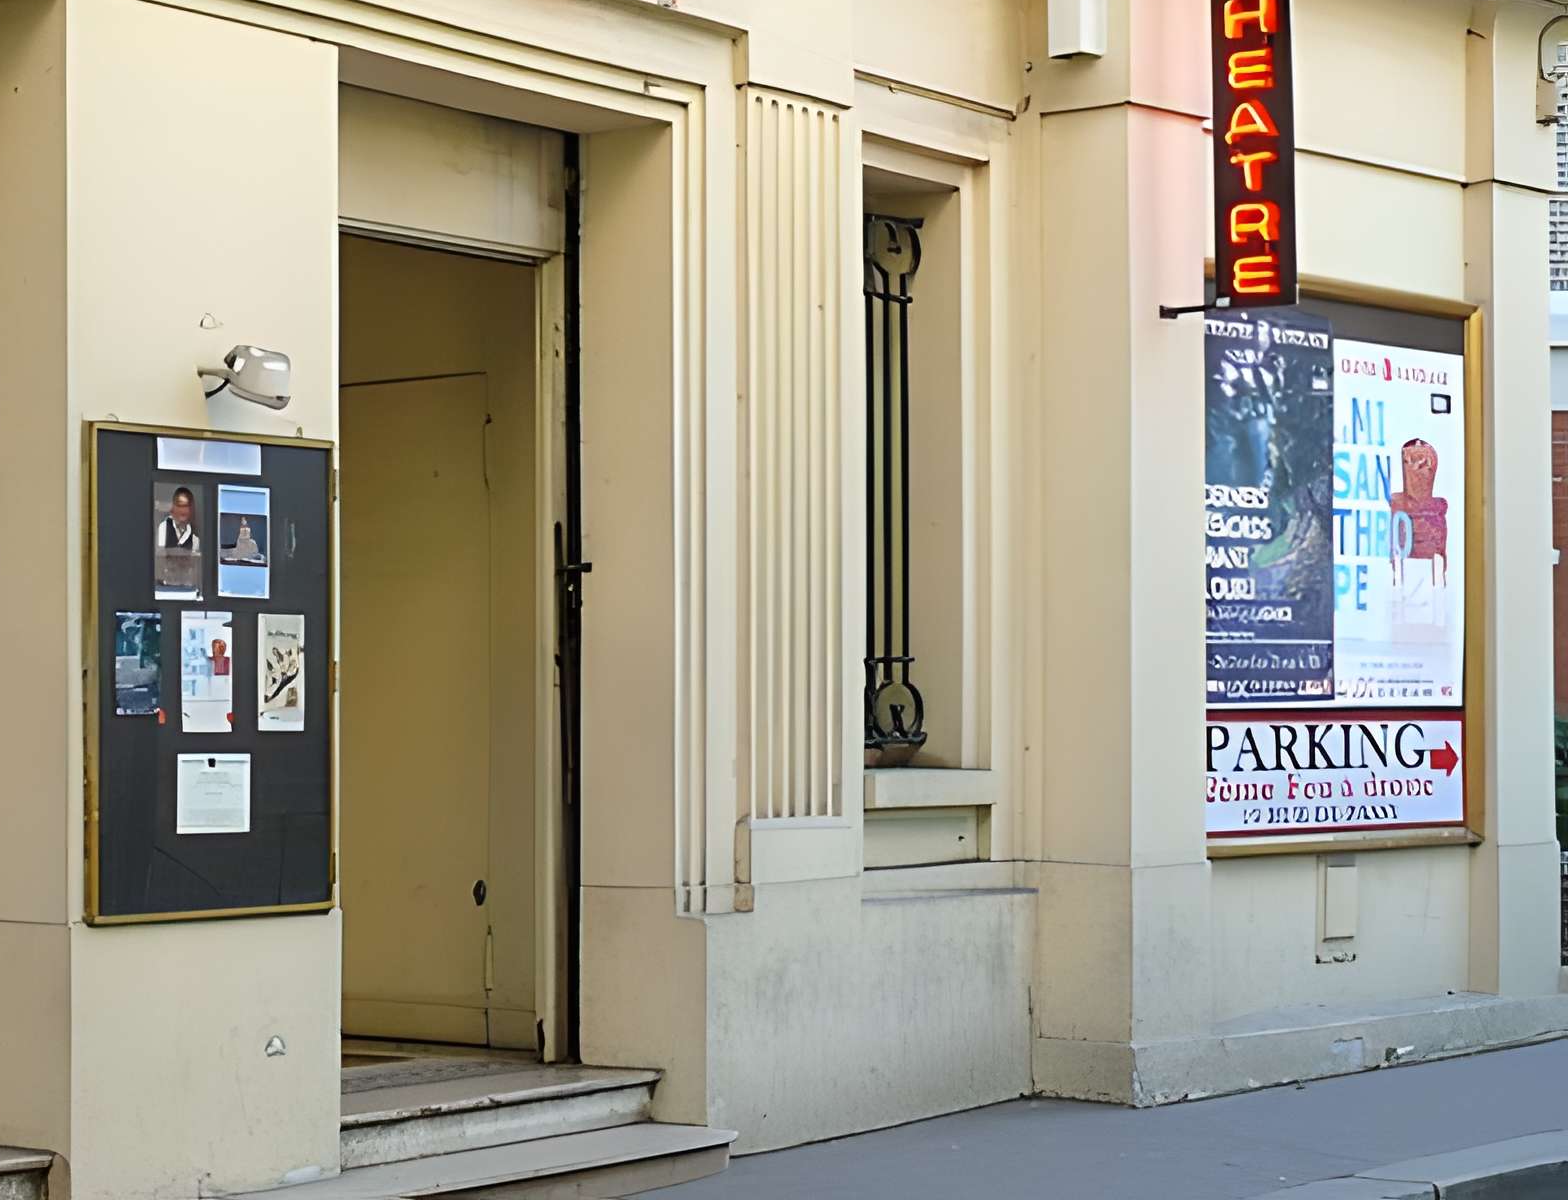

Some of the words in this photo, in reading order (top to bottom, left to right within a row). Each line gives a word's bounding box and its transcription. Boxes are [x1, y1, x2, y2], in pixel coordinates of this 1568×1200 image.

[1332, 450, 1392, 504] SAN
[1332, 508, 1414, 562] THRO
[1333, 564, 1368, 611] PE
[1206, 723, 1425, 772] PARKING
